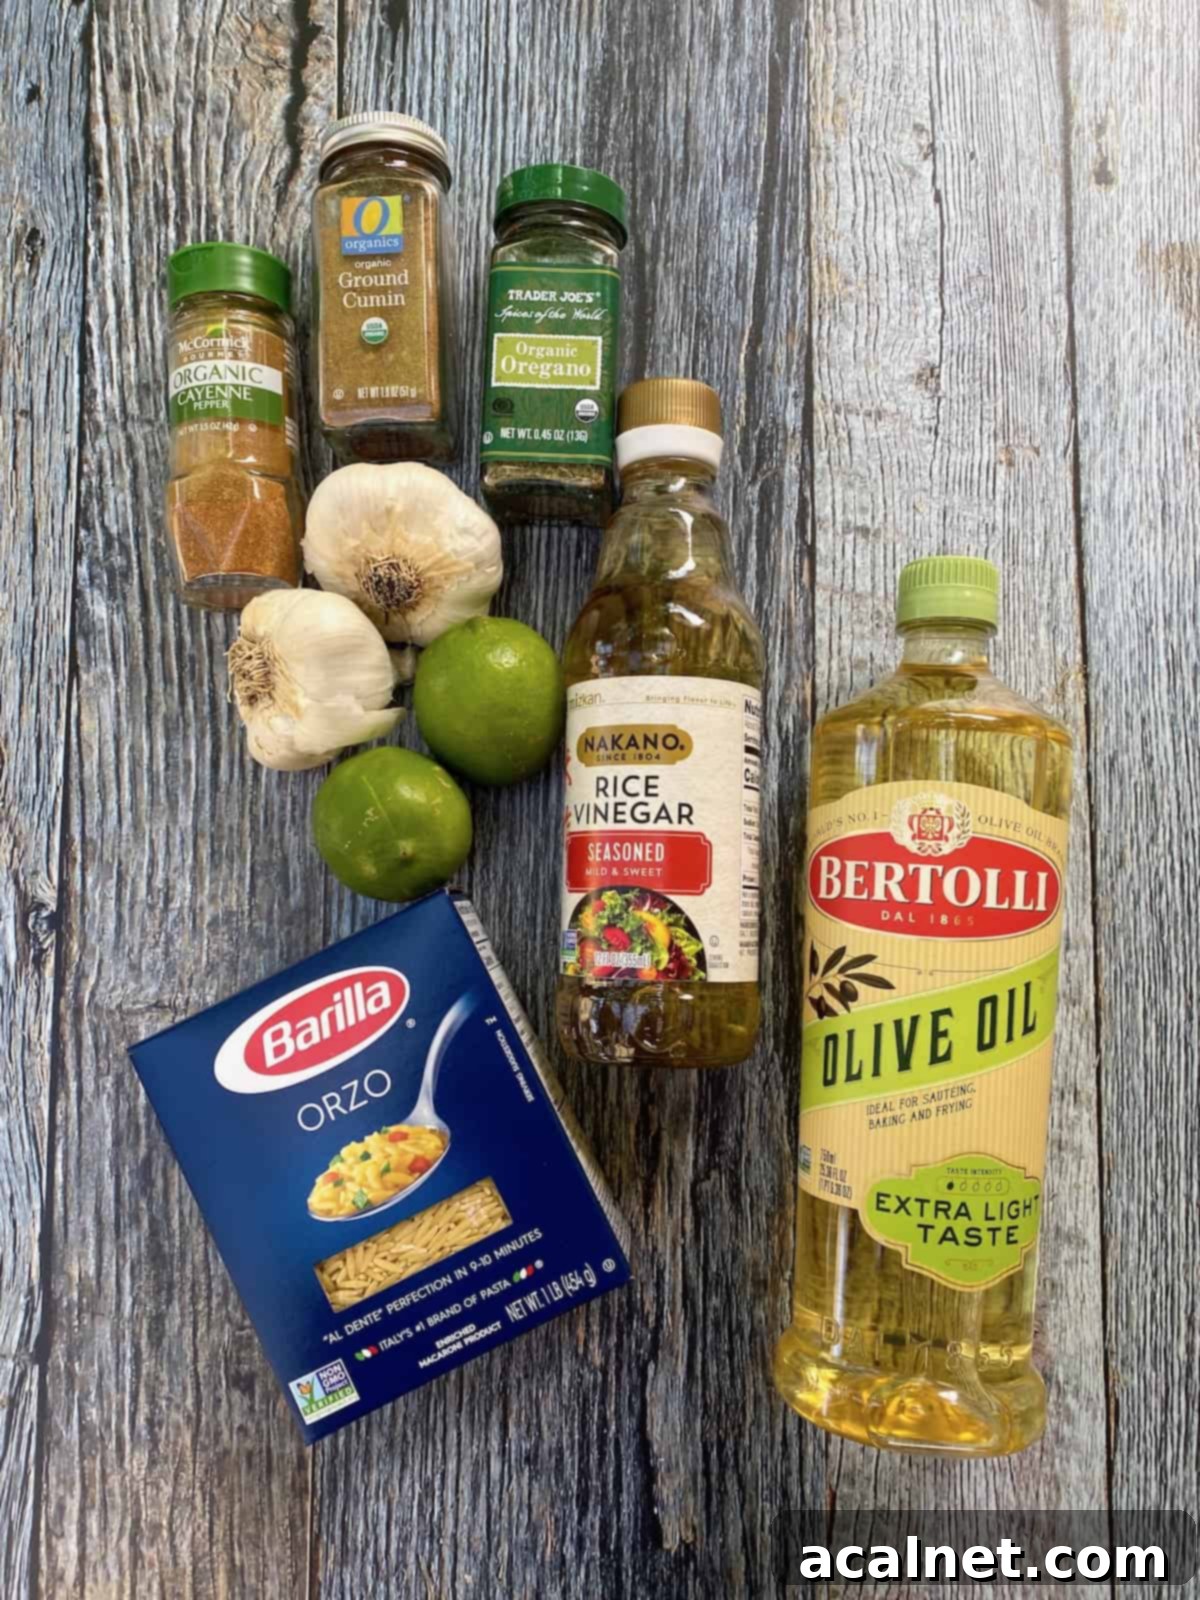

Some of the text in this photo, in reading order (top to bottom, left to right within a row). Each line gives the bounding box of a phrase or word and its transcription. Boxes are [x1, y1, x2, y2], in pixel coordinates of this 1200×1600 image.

[344, 236, 399, 252] organics
[354, 258, 391, 269] organic
[338, 270, 409, 288] Ground
[342, 291, 405, 309] Cumin
[508, 289, 594, 303] TRADER JOE'S
[494, 305, 533, 323] Spices
[533, 307, 549, 324] of
[572, 306, 608, 321] World
[515, 340, 578, 358] Organic
[173, 365, 263, 389] ORGANIC
[500, 354, 592, 379] Oregano
[177, 385, 253, 405] CAYENNE
[193, 399, 229, 411] PEPPER
[499, 427, 516, 439] NET
[533, 428, 552, 440] 0.45
[553, 429, 565, 440] OZ
[596, 752, 661, 762] SINCE 1804
[595, 775, 660, 798] RICE
[574, 801, 694, 825] VINEGAR
[848, 813, 870, 824] NO.
[978, 814, 1044, 844] OLIVE OIL
[587, 842, 665, 862] SEASONED
[585, 867, 663, 877] MILD & SWEET
[818, 855, 1049, 912] BERTOLLI
[881, 910, 916, 923] DAL
[262, 980, 391, 1068] Barilla
[822, 981, 1037, 1087] OLIVE OIL
[297, 1069, 391, 1131] ORZO
[866, 1102, 895, 1115] IDEAL
[899, 1096, 919, 1110] FOR
[869, 1099, 973, 1130] BAKING AND FRYING
[875, 1192, 972, 1221] EXTRA
[917, 1224, 1019, 1246] TASTE
[387, 1277, 452, 1314] PERFECTION
[453, 1266, 468, 1281] IN
[469, 1253, 493, 1272] 9-10
[494, 1228, 542, 1259] MINUTES
[504, 1298, 528, 1323] NET
[522, 1291, 546, 1313] WT.
[549, 1281, 564, 1301] LB
[561, 1269, 586, 1297] (454
[583, 1262, 598, 1288] g)
[378, 1330, 413, 1351] ITALY'S
[427, 1304, 462, 1327] BRAND
[463, 1294, 479, 1308] OF
[479, 1278, 512, 1300] PASTA
[419, 1321, 501, 1367] MACARONI PRODUCT
[436, 1324, 476, 1347] ENRICHED
[318, 1364, 343, 1380] NON
